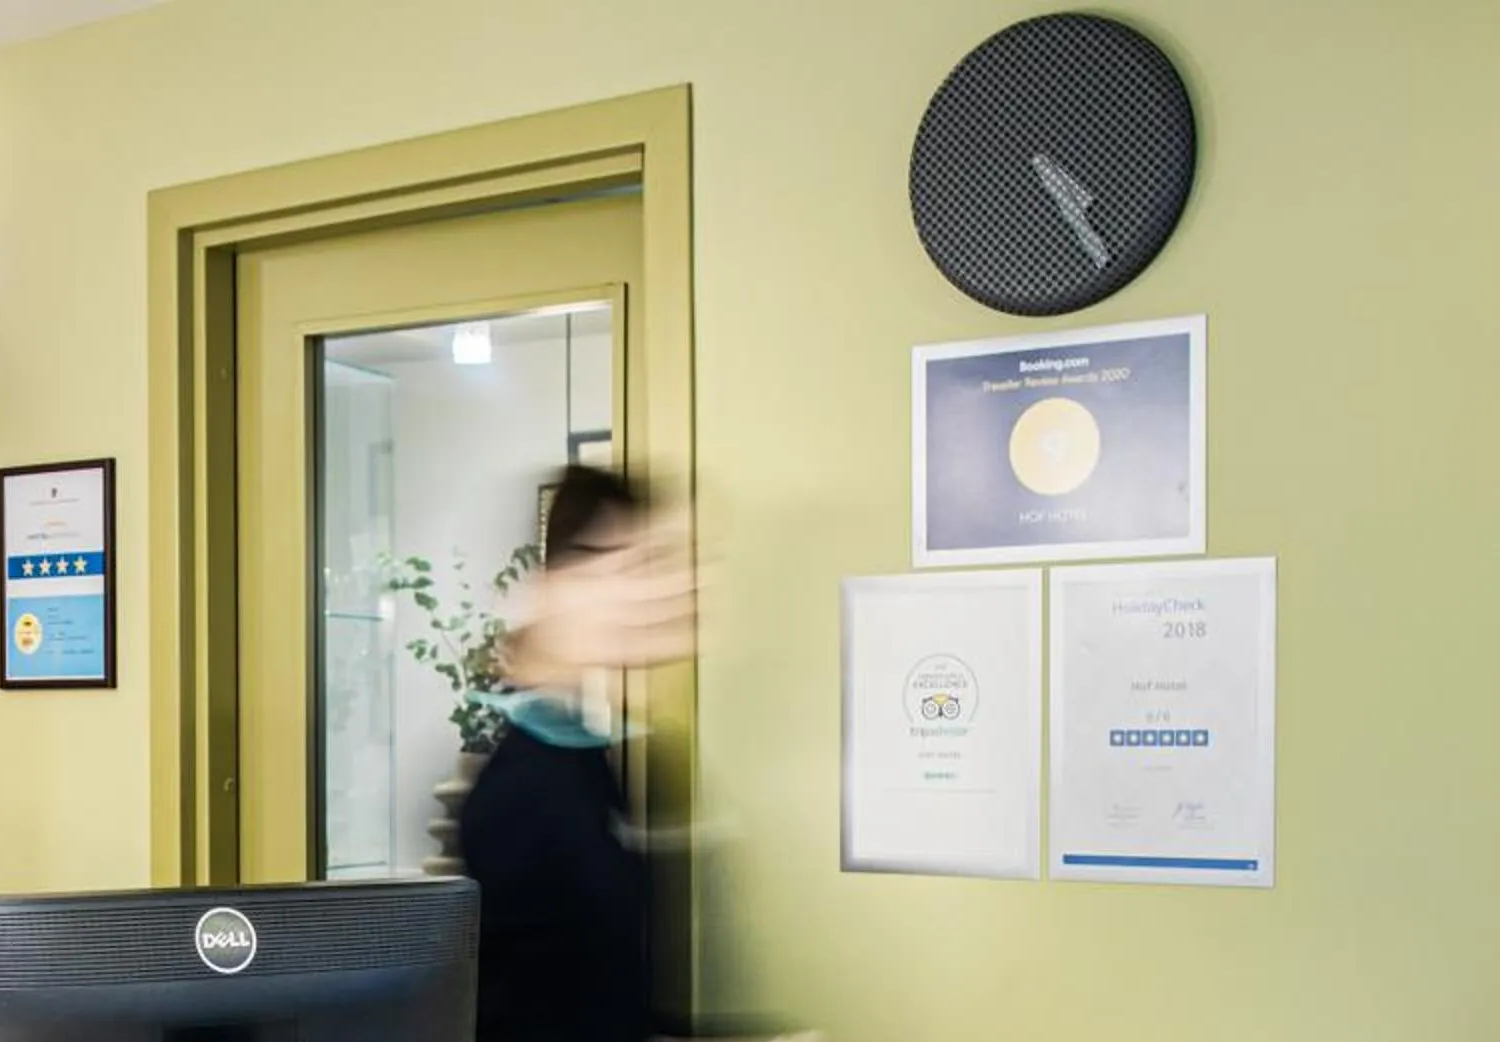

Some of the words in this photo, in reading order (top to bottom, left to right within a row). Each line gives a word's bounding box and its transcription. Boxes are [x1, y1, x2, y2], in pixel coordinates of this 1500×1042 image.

[1019, 356, 1090, 373] Booking.com
[1100, 368, 1131, 382] 2020
[1111, 598, 1204, 616] HolidayCheck
[1162, 620, 1208, 639] 2018
[202, 931, 251, 949] DELL
